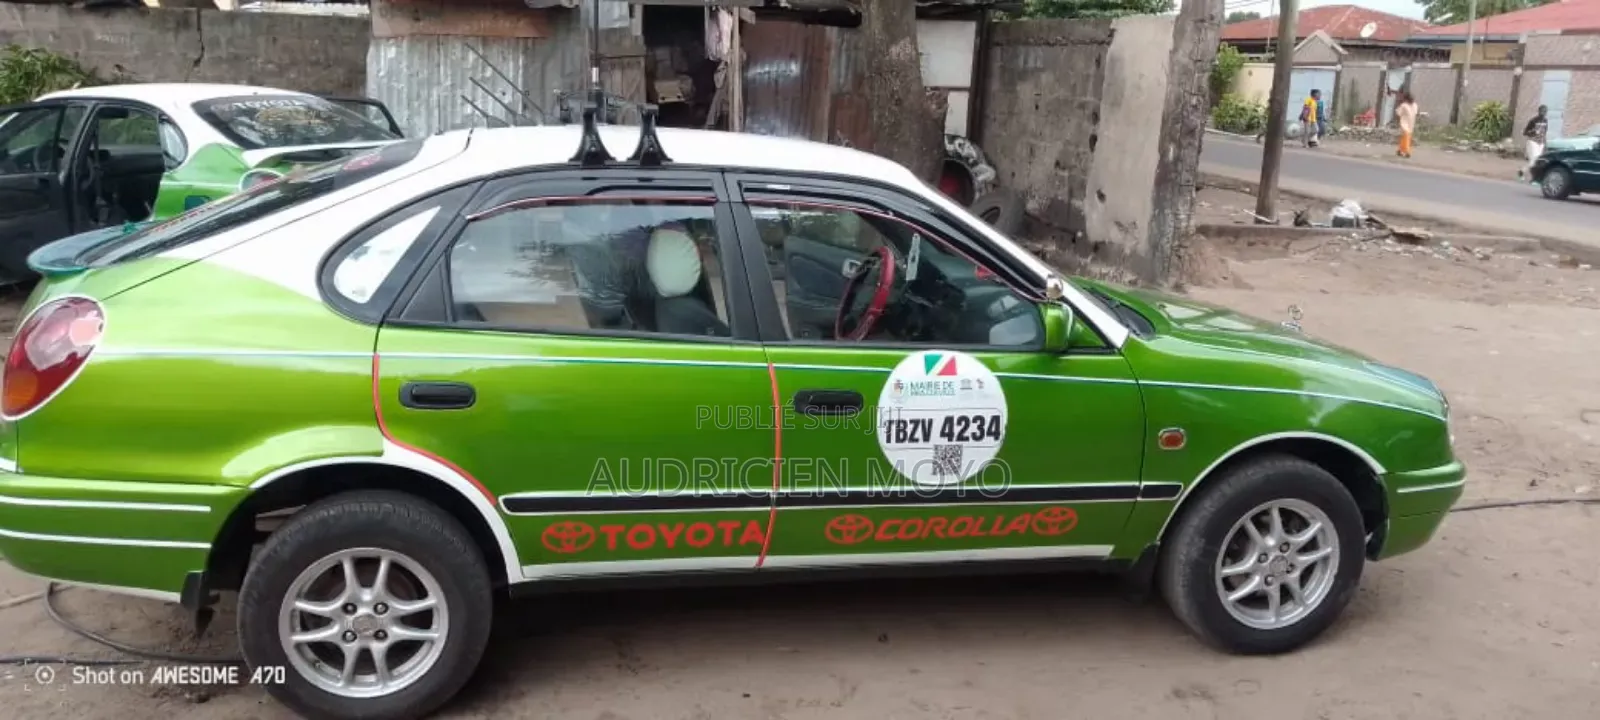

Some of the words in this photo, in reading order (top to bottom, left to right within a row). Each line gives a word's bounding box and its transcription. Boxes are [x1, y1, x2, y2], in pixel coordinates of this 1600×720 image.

[885, 418, 934, 444] TBZV
[939, 414, 1001, 443] 4234
[600, 520, 766, 551] TOYOTA
[874, 513, 1032, 542] COROLLA
